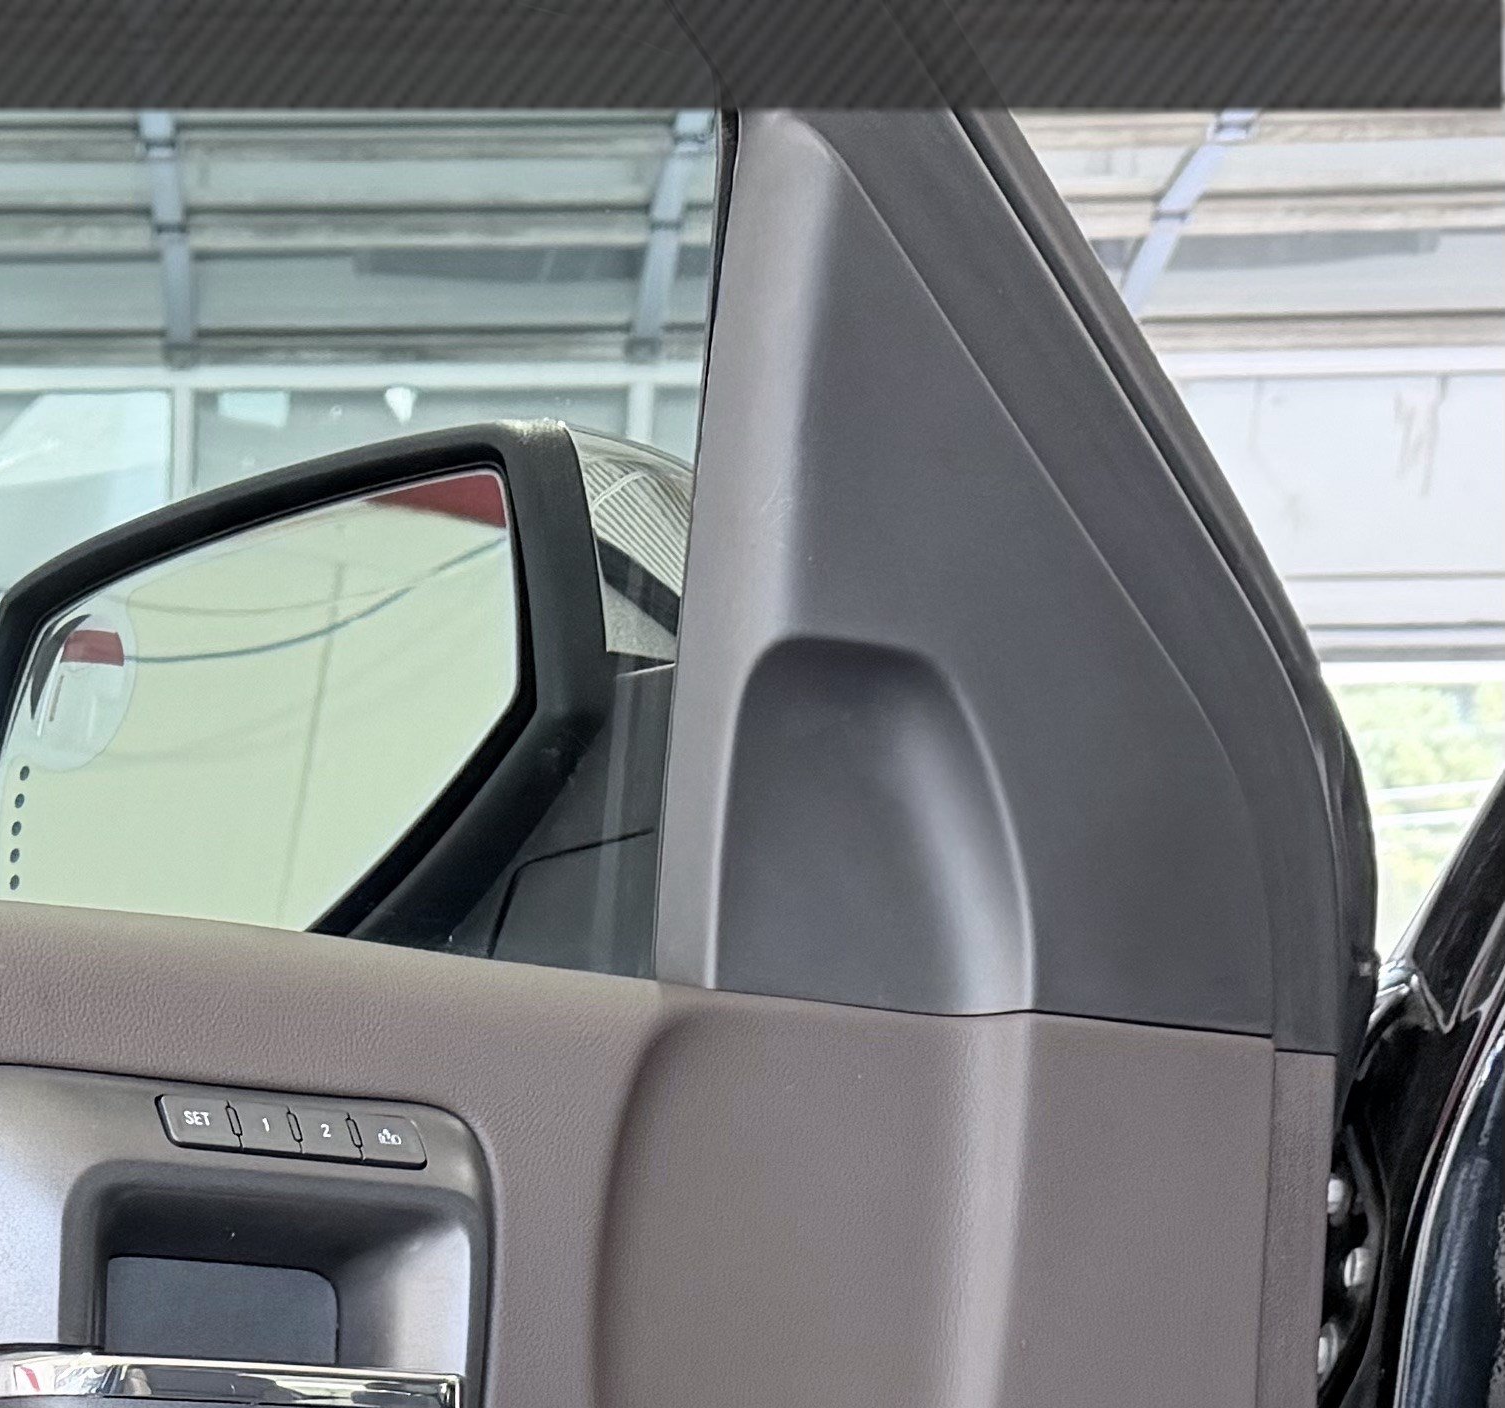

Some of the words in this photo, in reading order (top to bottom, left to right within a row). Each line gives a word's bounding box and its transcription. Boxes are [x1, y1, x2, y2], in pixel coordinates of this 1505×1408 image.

[183, 1110, 211, 1126] SET
[262, 1117, 270, 1132] 1
[320, 1123, 332, 1138] 2
